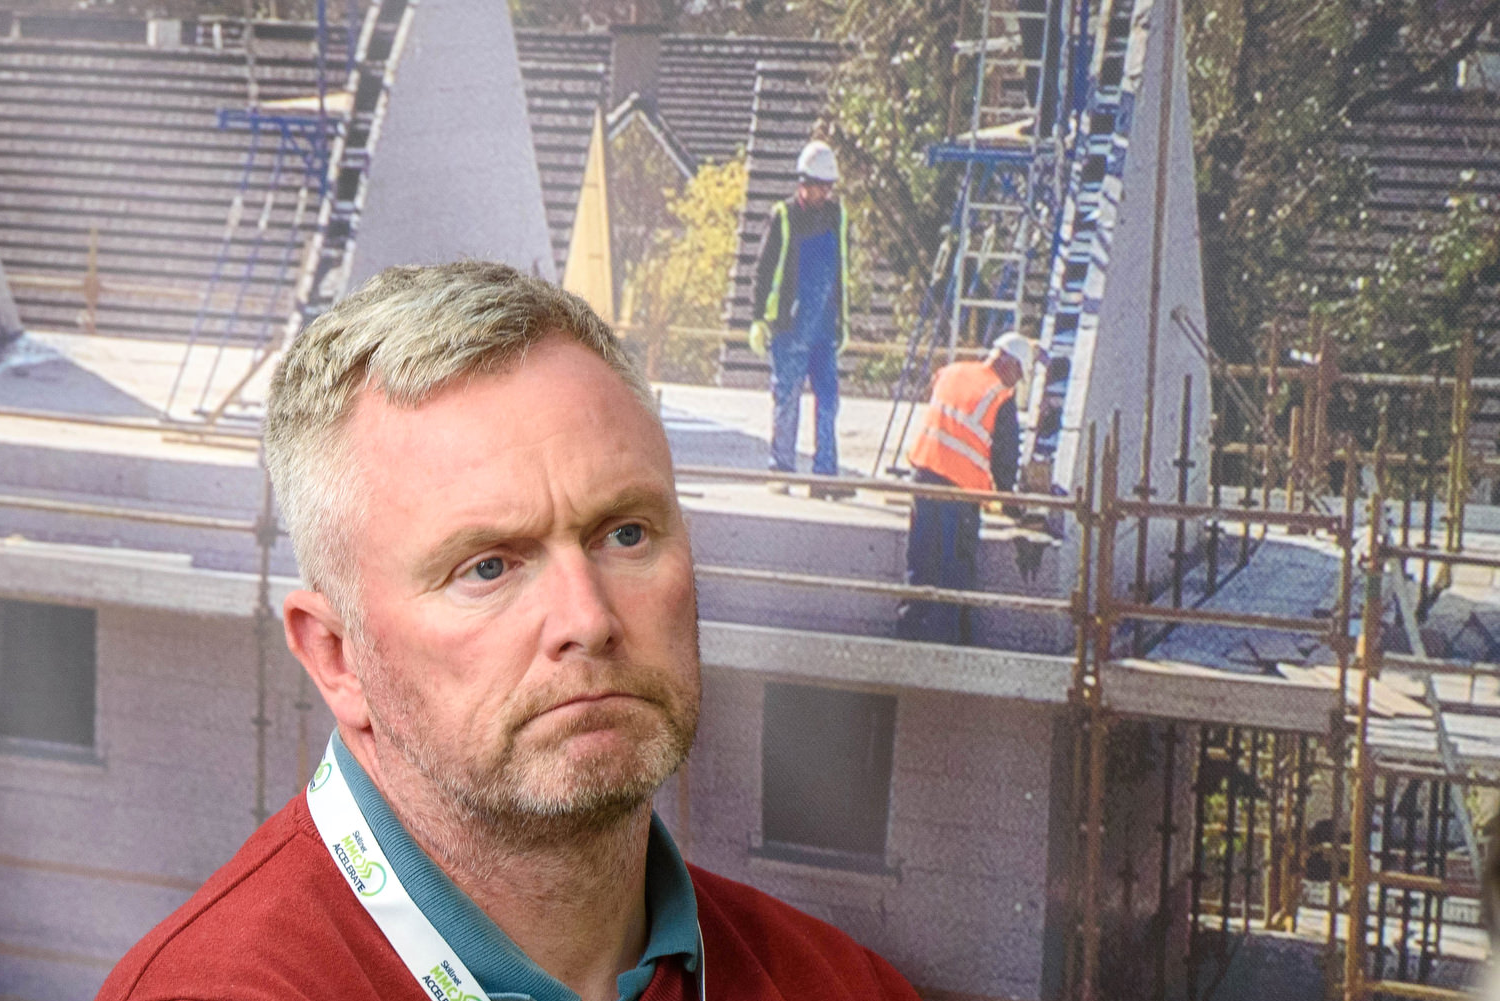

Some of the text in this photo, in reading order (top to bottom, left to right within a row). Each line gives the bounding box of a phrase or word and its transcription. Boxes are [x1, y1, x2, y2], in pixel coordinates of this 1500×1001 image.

[341, 835, 362, 864] MMC
[332, 843, 365, 893] ACCELERATE
[430, 965, 458, 998] MMC
[440, 959, 462, 987] Skillnet
